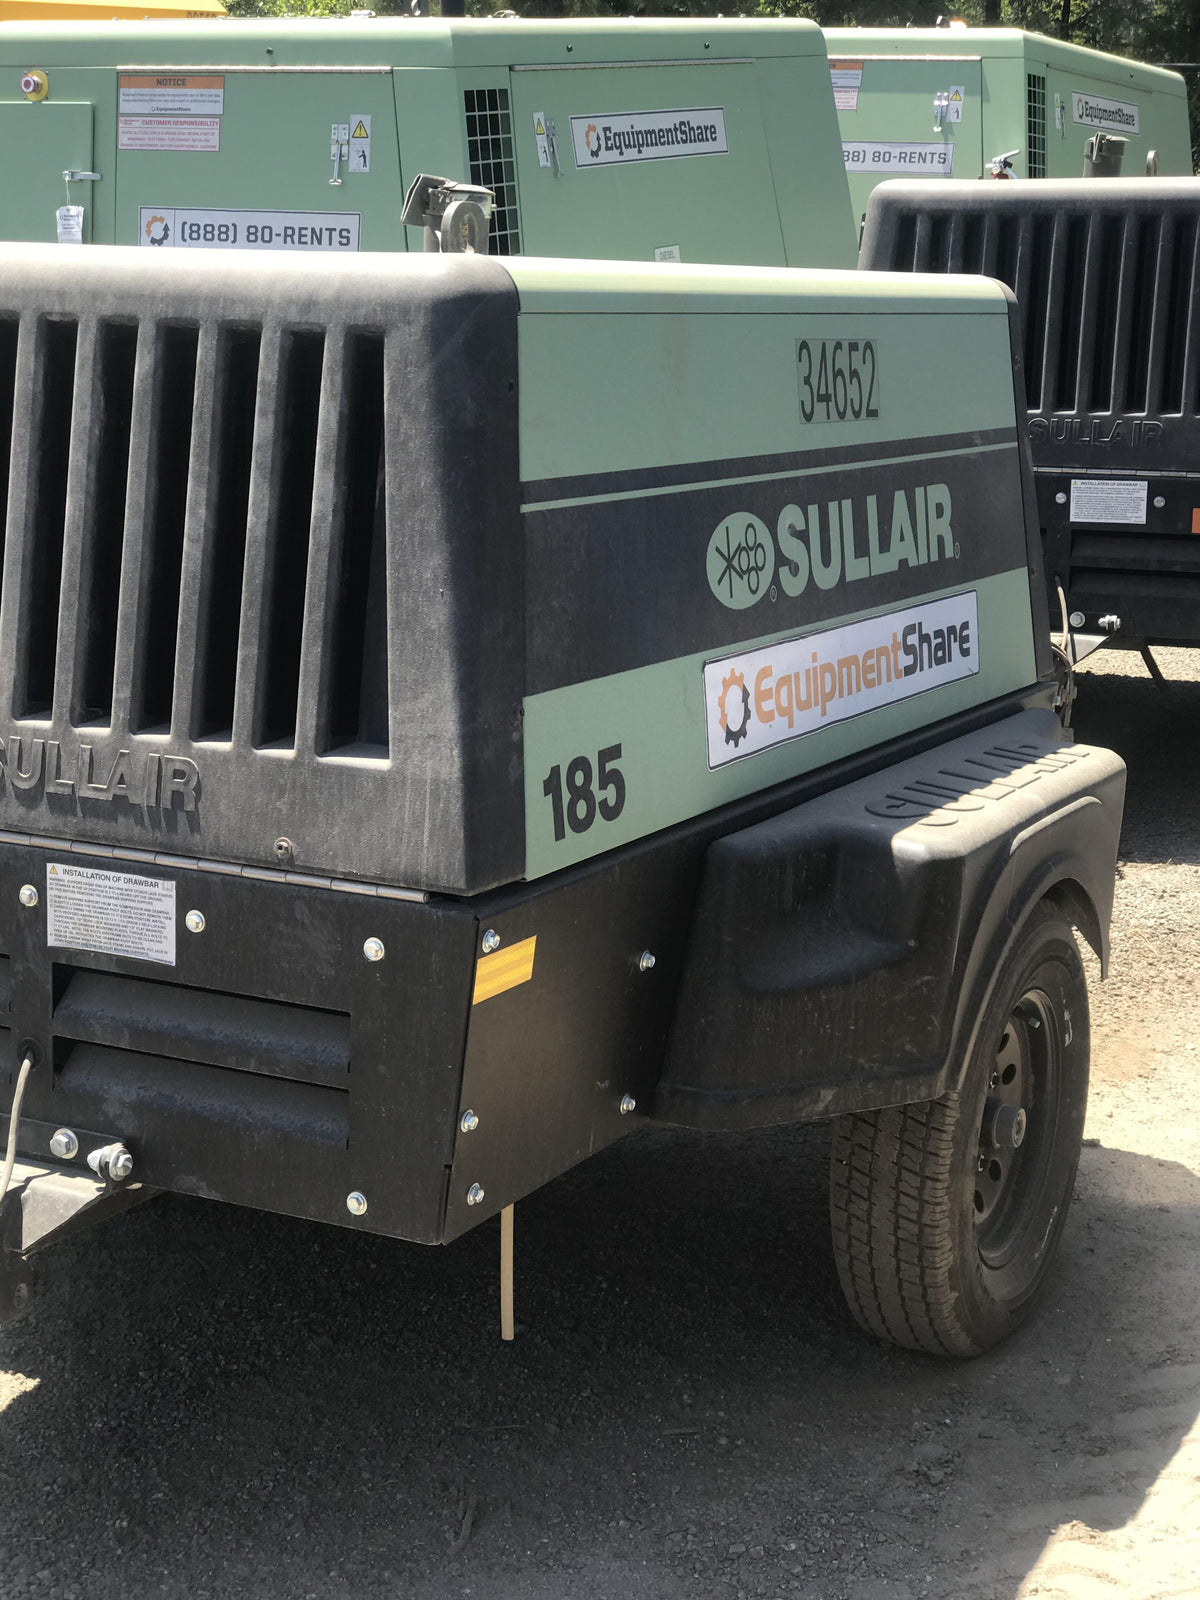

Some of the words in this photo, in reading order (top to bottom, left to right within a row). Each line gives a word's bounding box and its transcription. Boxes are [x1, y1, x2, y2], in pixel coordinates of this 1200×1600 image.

[156, 78, 187, 87] NOTICE
[1084, 101, 1135, 126] EquipmentShare
[602, 120, 718, 156] EquipmentShare
[872, 150, 947, 165] 80-RENTS
[181, 221, 238, 244] (888)
[246, 224, 352, 247] 80-RENTS
[798, 340, 879, 422] 34652
[1028, 418, 1164, 448] SULLAIR
[777, 482, 955, 598] SULLAIR
[753, 620, 971, 730] EquipmentShare
[0, 735, 200, 812] ULLAIR
[542, 742, 626, 842] 185
[62, 868, 111, 882] INSTALLATION
[111, 875, 122, 883] OF
[123, 877, 159, 889] DRAWBAR
